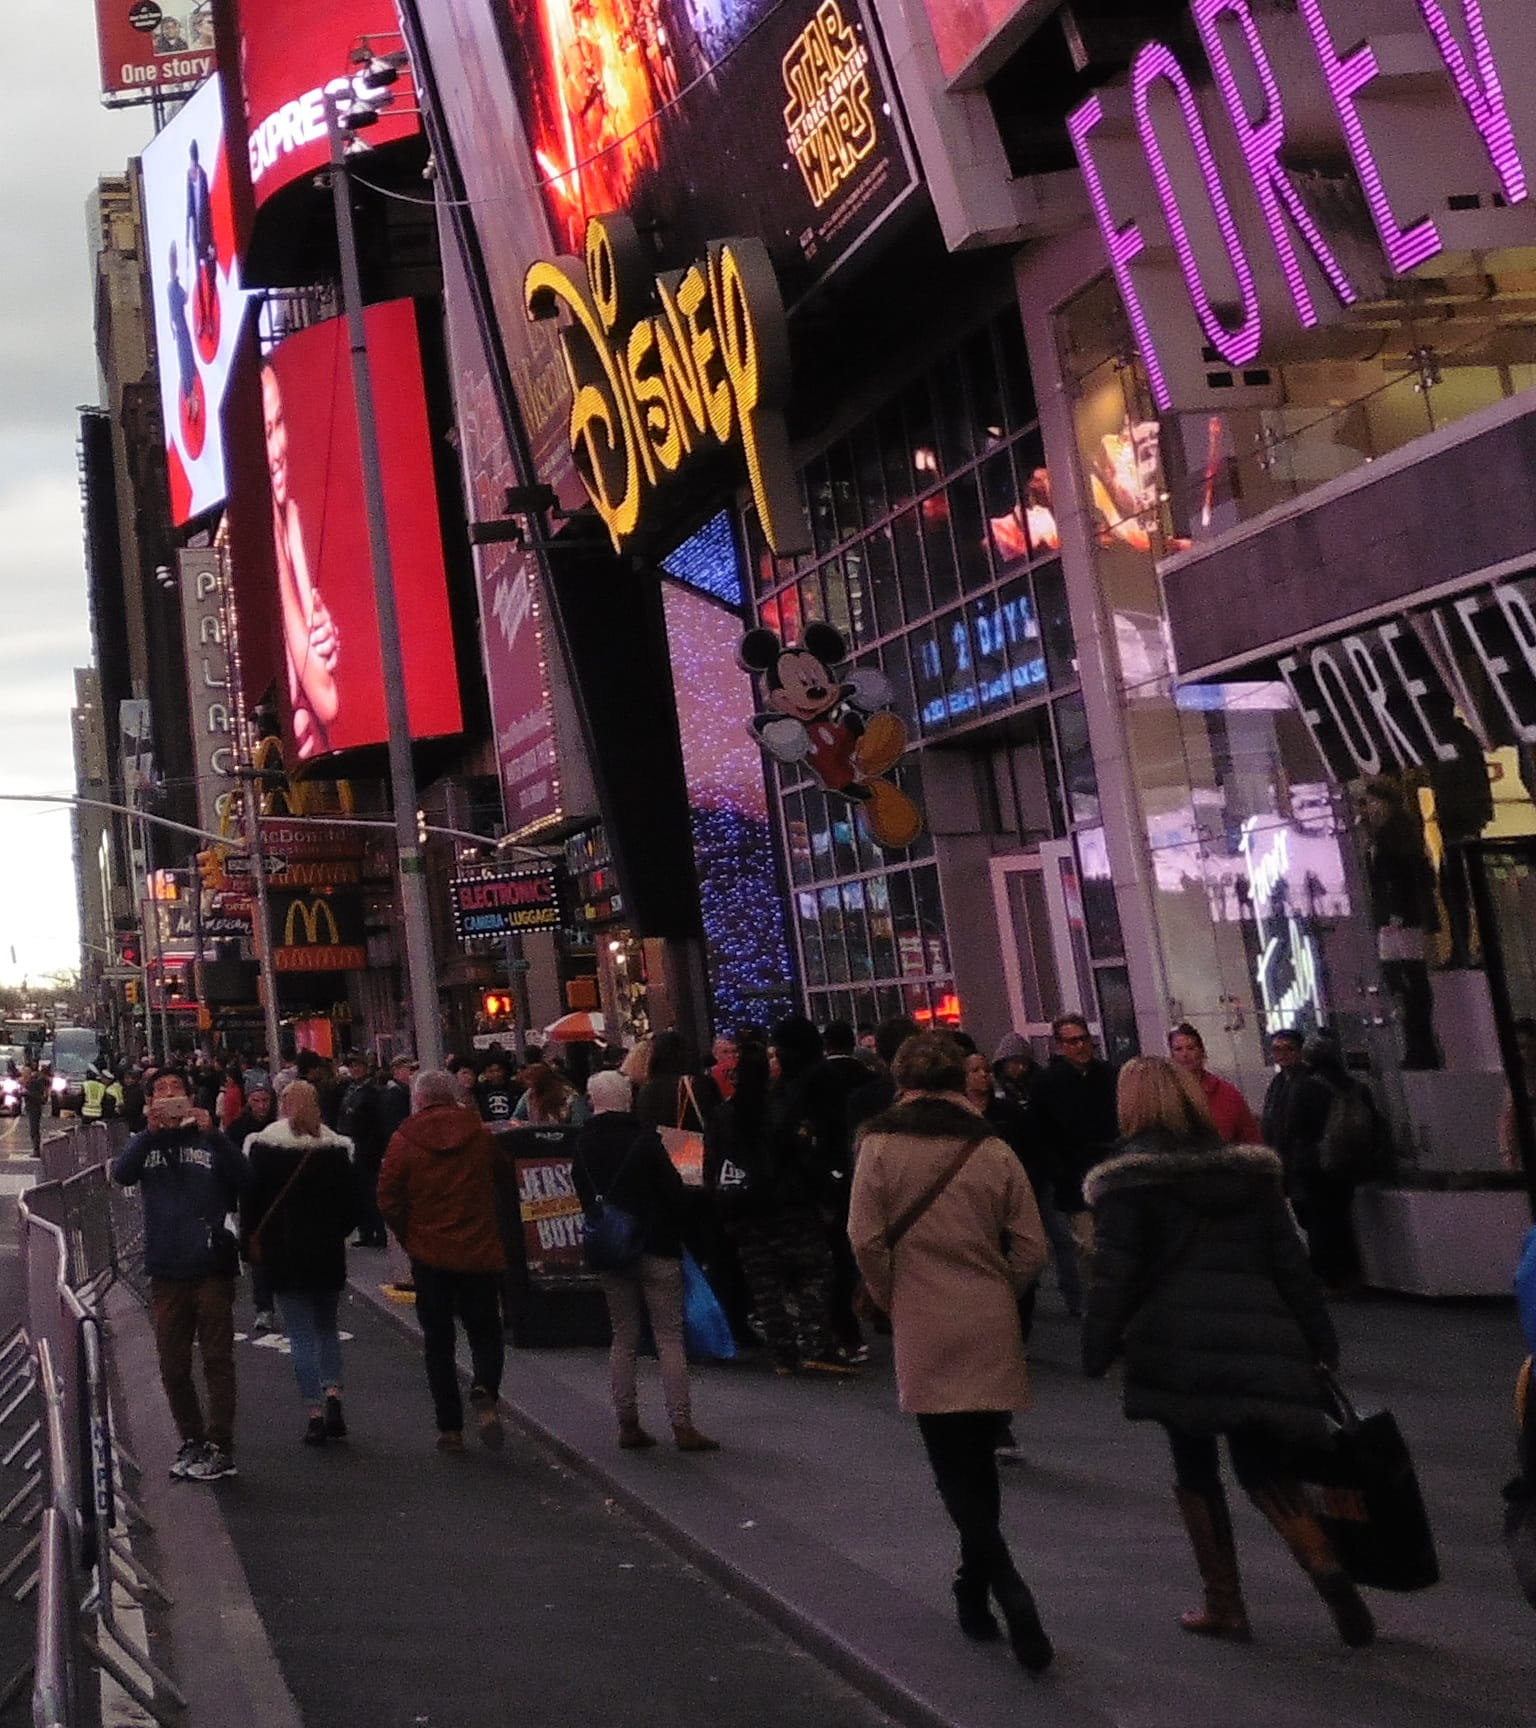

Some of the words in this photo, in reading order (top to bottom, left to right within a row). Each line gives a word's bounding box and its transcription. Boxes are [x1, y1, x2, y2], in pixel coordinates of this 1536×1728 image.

[121, 64, 157, 84] One
[162, 56, 211, 80] story
[795, 70, 876, 208] WARS
[460, 879, 552, 910] ELECTRONICS
[508, 908, 557, 927] LUGGAGE
